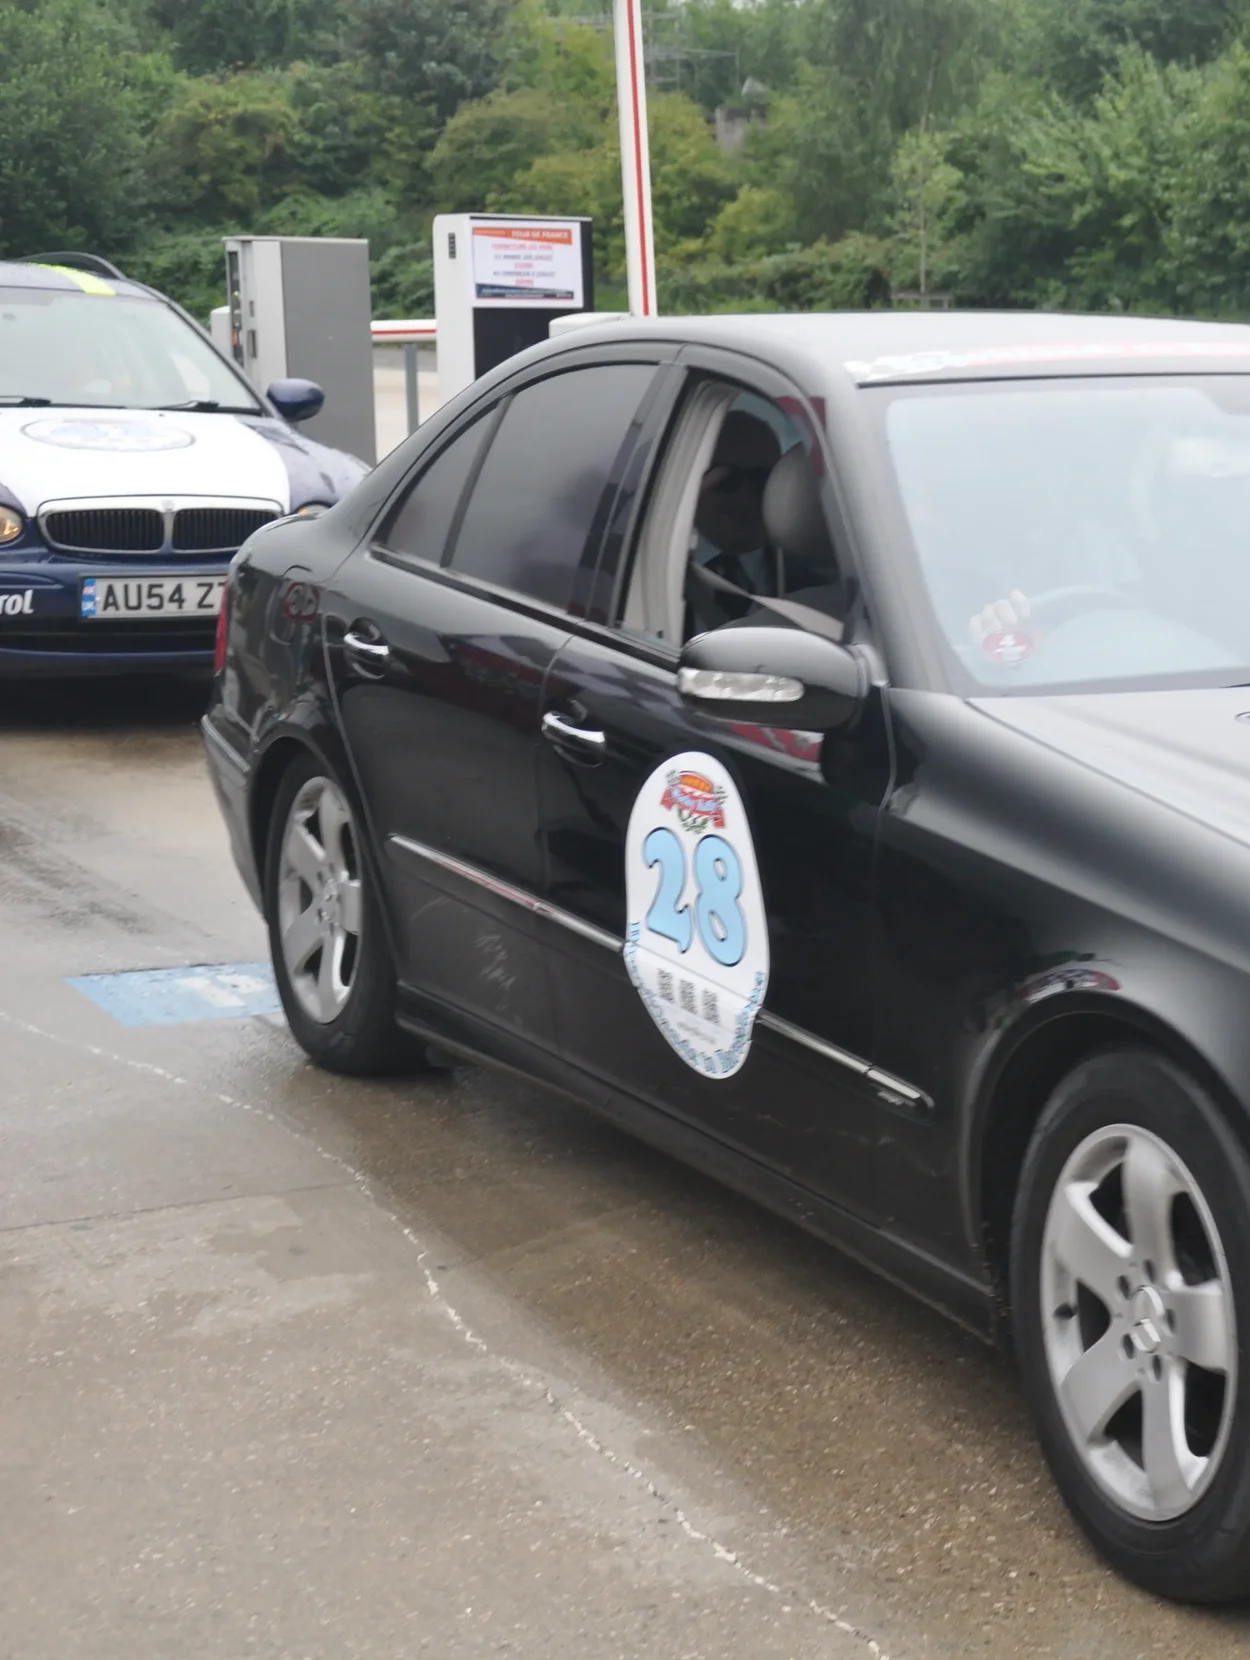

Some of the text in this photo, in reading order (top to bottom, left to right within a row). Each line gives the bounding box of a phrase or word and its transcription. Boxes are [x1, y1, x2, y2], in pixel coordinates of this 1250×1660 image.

[102, 582, 227, 611] AU54 Z
[642, 826, 749, 967] 28
